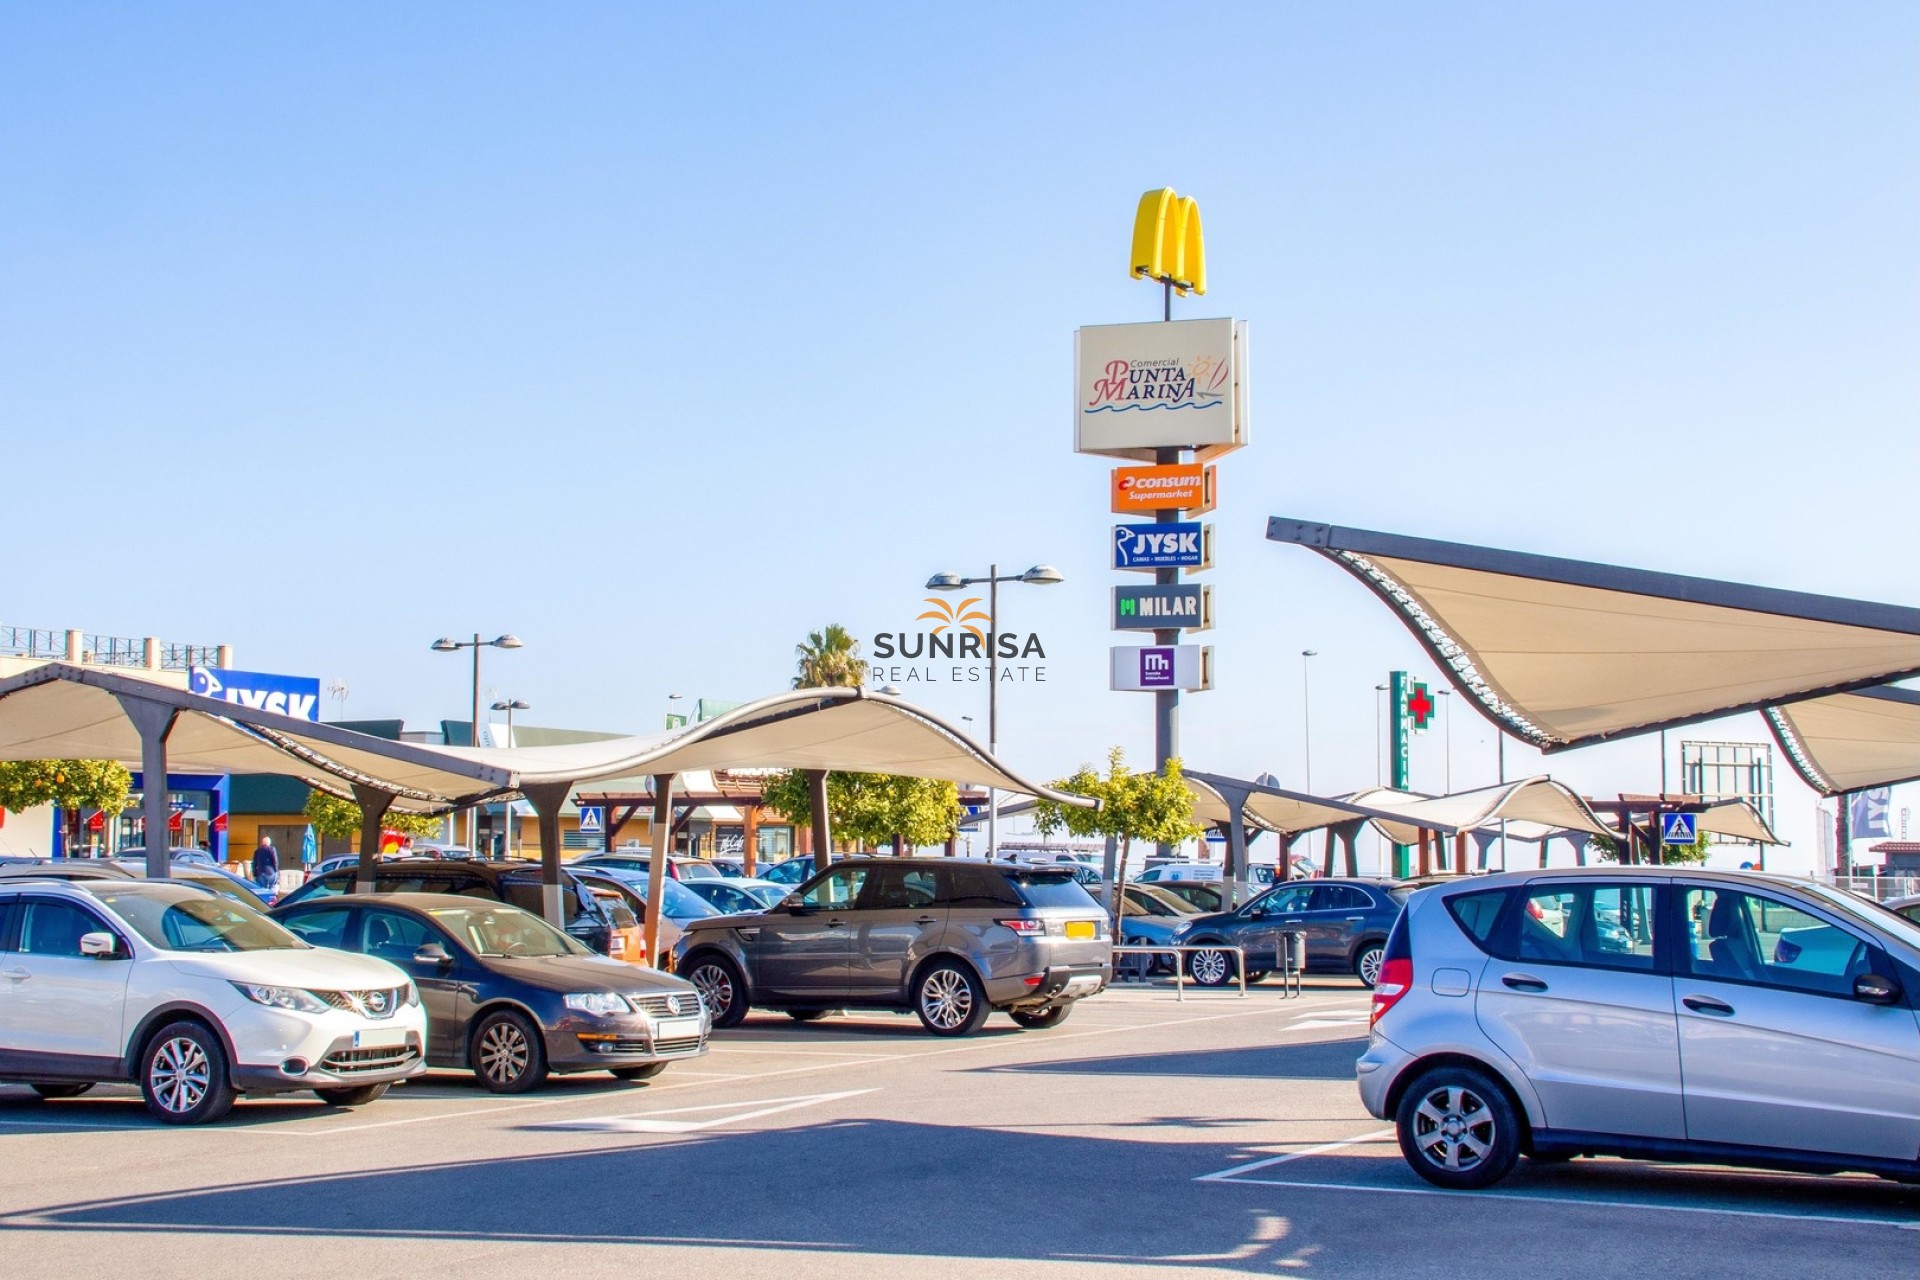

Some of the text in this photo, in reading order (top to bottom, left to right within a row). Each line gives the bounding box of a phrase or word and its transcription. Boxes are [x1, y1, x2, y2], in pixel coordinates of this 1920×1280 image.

[1105, 359, 1187, 385] PUNTA
[1130, 357, 1180, 369] Comercial
[1089, 377, 1196, 406] MARINA
[1136, 475, 1202, 489] consum
[1128, 489, 1193, 501] Supermarket
[1132, 532, 1198, 555] JYSK
[1139, 596, 1197, 616] MILAR
[1400, 676, 1408, 787] FARMACIA
[1867, 786, 1889, 837] JYS
[720, 834, 744, 852] McCaf
